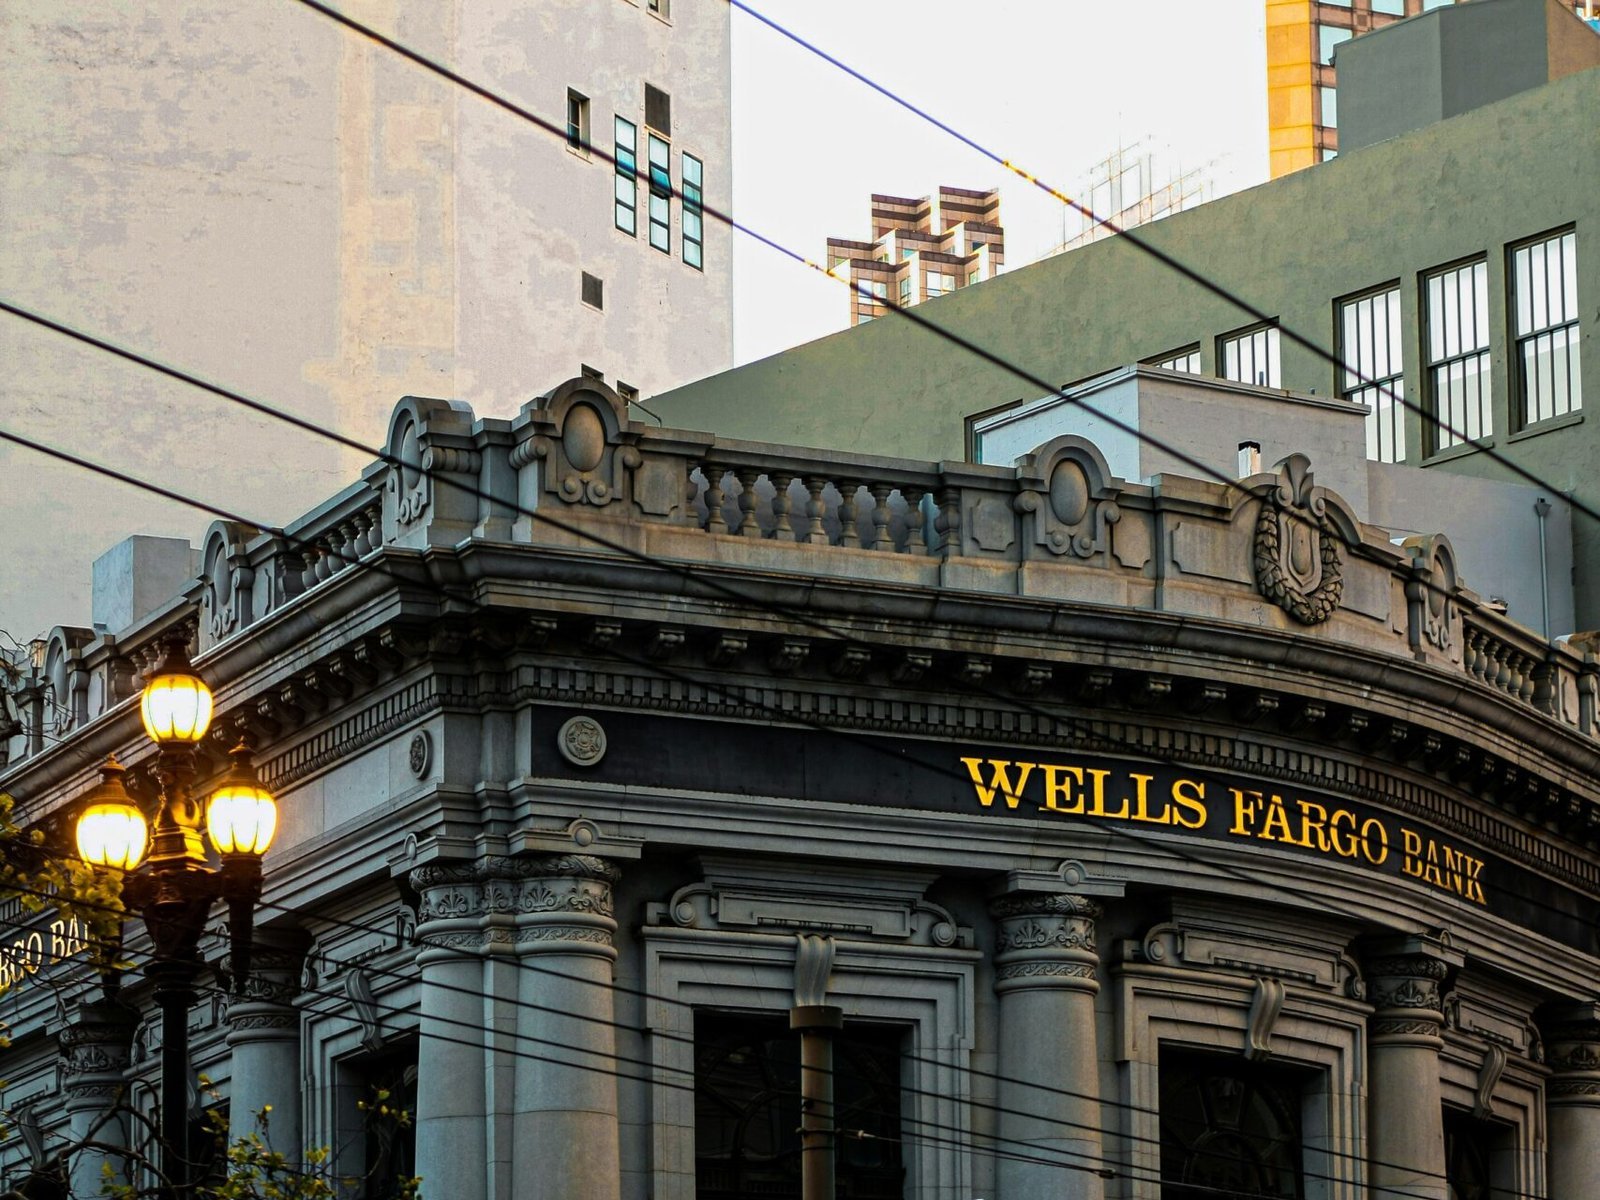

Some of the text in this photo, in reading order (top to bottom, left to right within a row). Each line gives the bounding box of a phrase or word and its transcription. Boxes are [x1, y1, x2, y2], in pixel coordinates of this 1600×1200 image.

[959, 756, 1487, 906] WELLS FARGO BANK
[49, 913, 89, 966] BA
